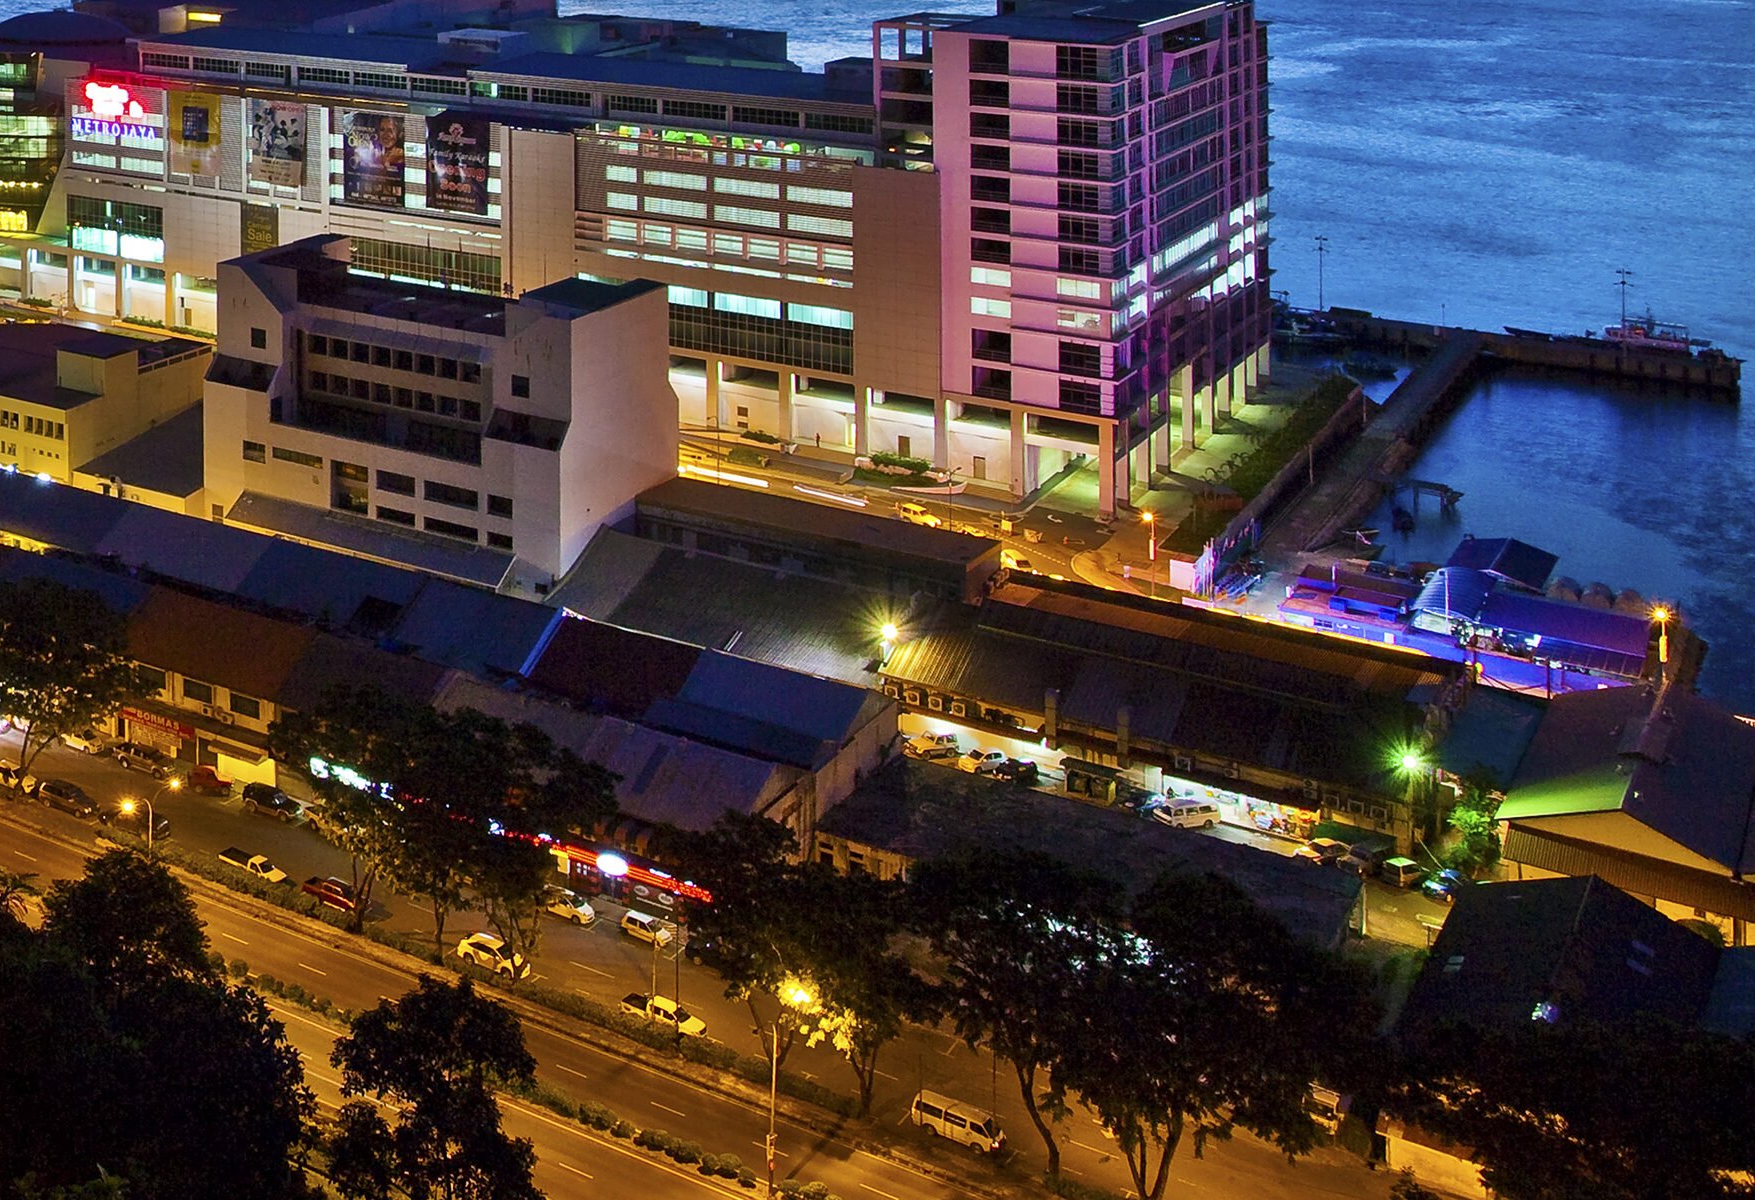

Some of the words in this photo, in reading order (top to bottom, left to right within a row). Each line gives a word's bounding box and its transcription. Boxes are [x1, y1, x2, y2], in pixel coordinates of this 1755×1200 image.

[71, 117, 156, 140] METROJAYA
[440, 178, 472, 194] Soon
[247, 228, 272, 243] Sale
